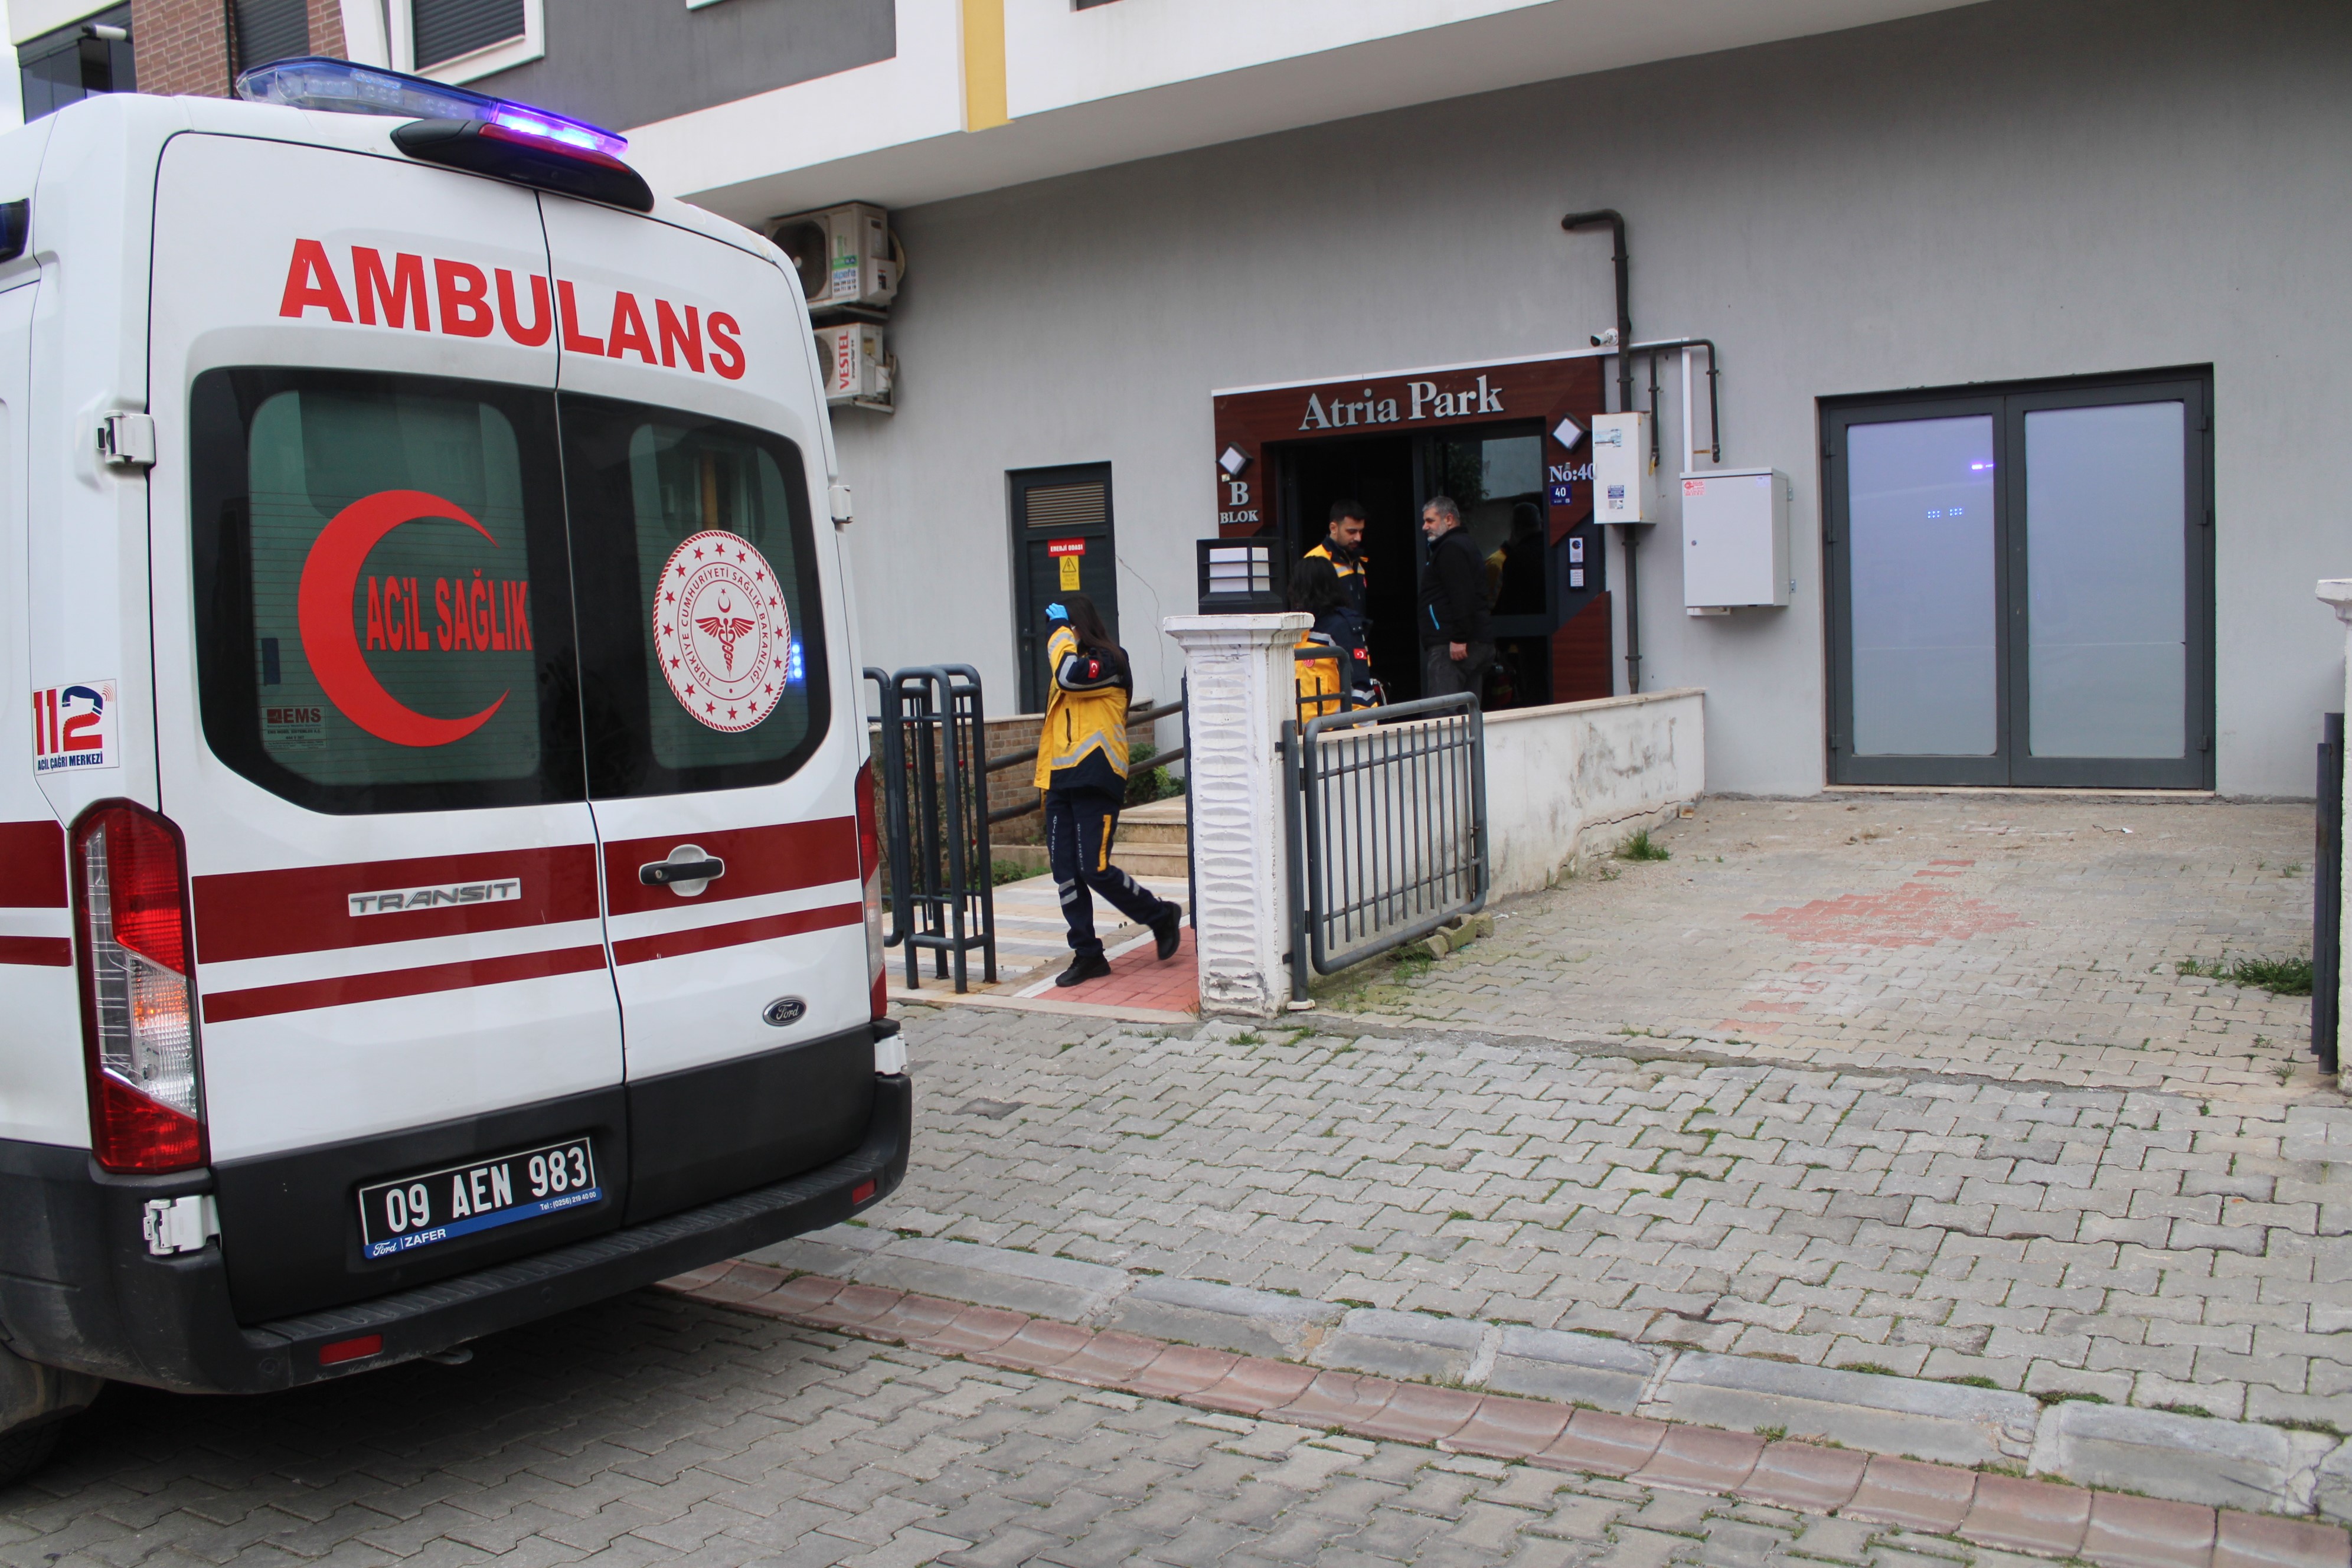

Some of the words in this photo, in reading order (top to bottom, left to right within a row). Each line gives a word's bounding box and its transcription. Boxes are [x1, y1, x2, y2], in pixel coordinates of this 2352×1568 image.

[279, 238, 746, 380] AMBULANS
[838, 331, 850, 390] VESTEL
[1299, 387, 1400, 430] Atria
[1407, 374, 1504, 420] Park
[1229, 481, 1249, 506] B
[1555, 486, 1567, 497] 40
[1219, 509, 1259, 524] BLOK
[435, 568, 534, 652] SAĞLIK
[732, 571, 762, 610] SAĞLIK
[750, 613, 769, 684] BAKANLIĞI
[33, 685, 103, 756] 112
[283, 708, 322, 724] EMS
[69, 751, 103, 767] MERKEZİ
[350, 882, 517, 913] TRANSIT
[776, 1003, 799, 1020] Ford
[386, 1184, 430, 1233] 09
[452, 1163, 513, 1219] AEN
[528, 1146, 587, 1197] 983
[553, 1197, 572, 1209] (0256)
[572, 1194, 582, 1203] 219
[373, 1241, 397, 1256] Ford
[404, 1229, 446, 1247] ZAFER
